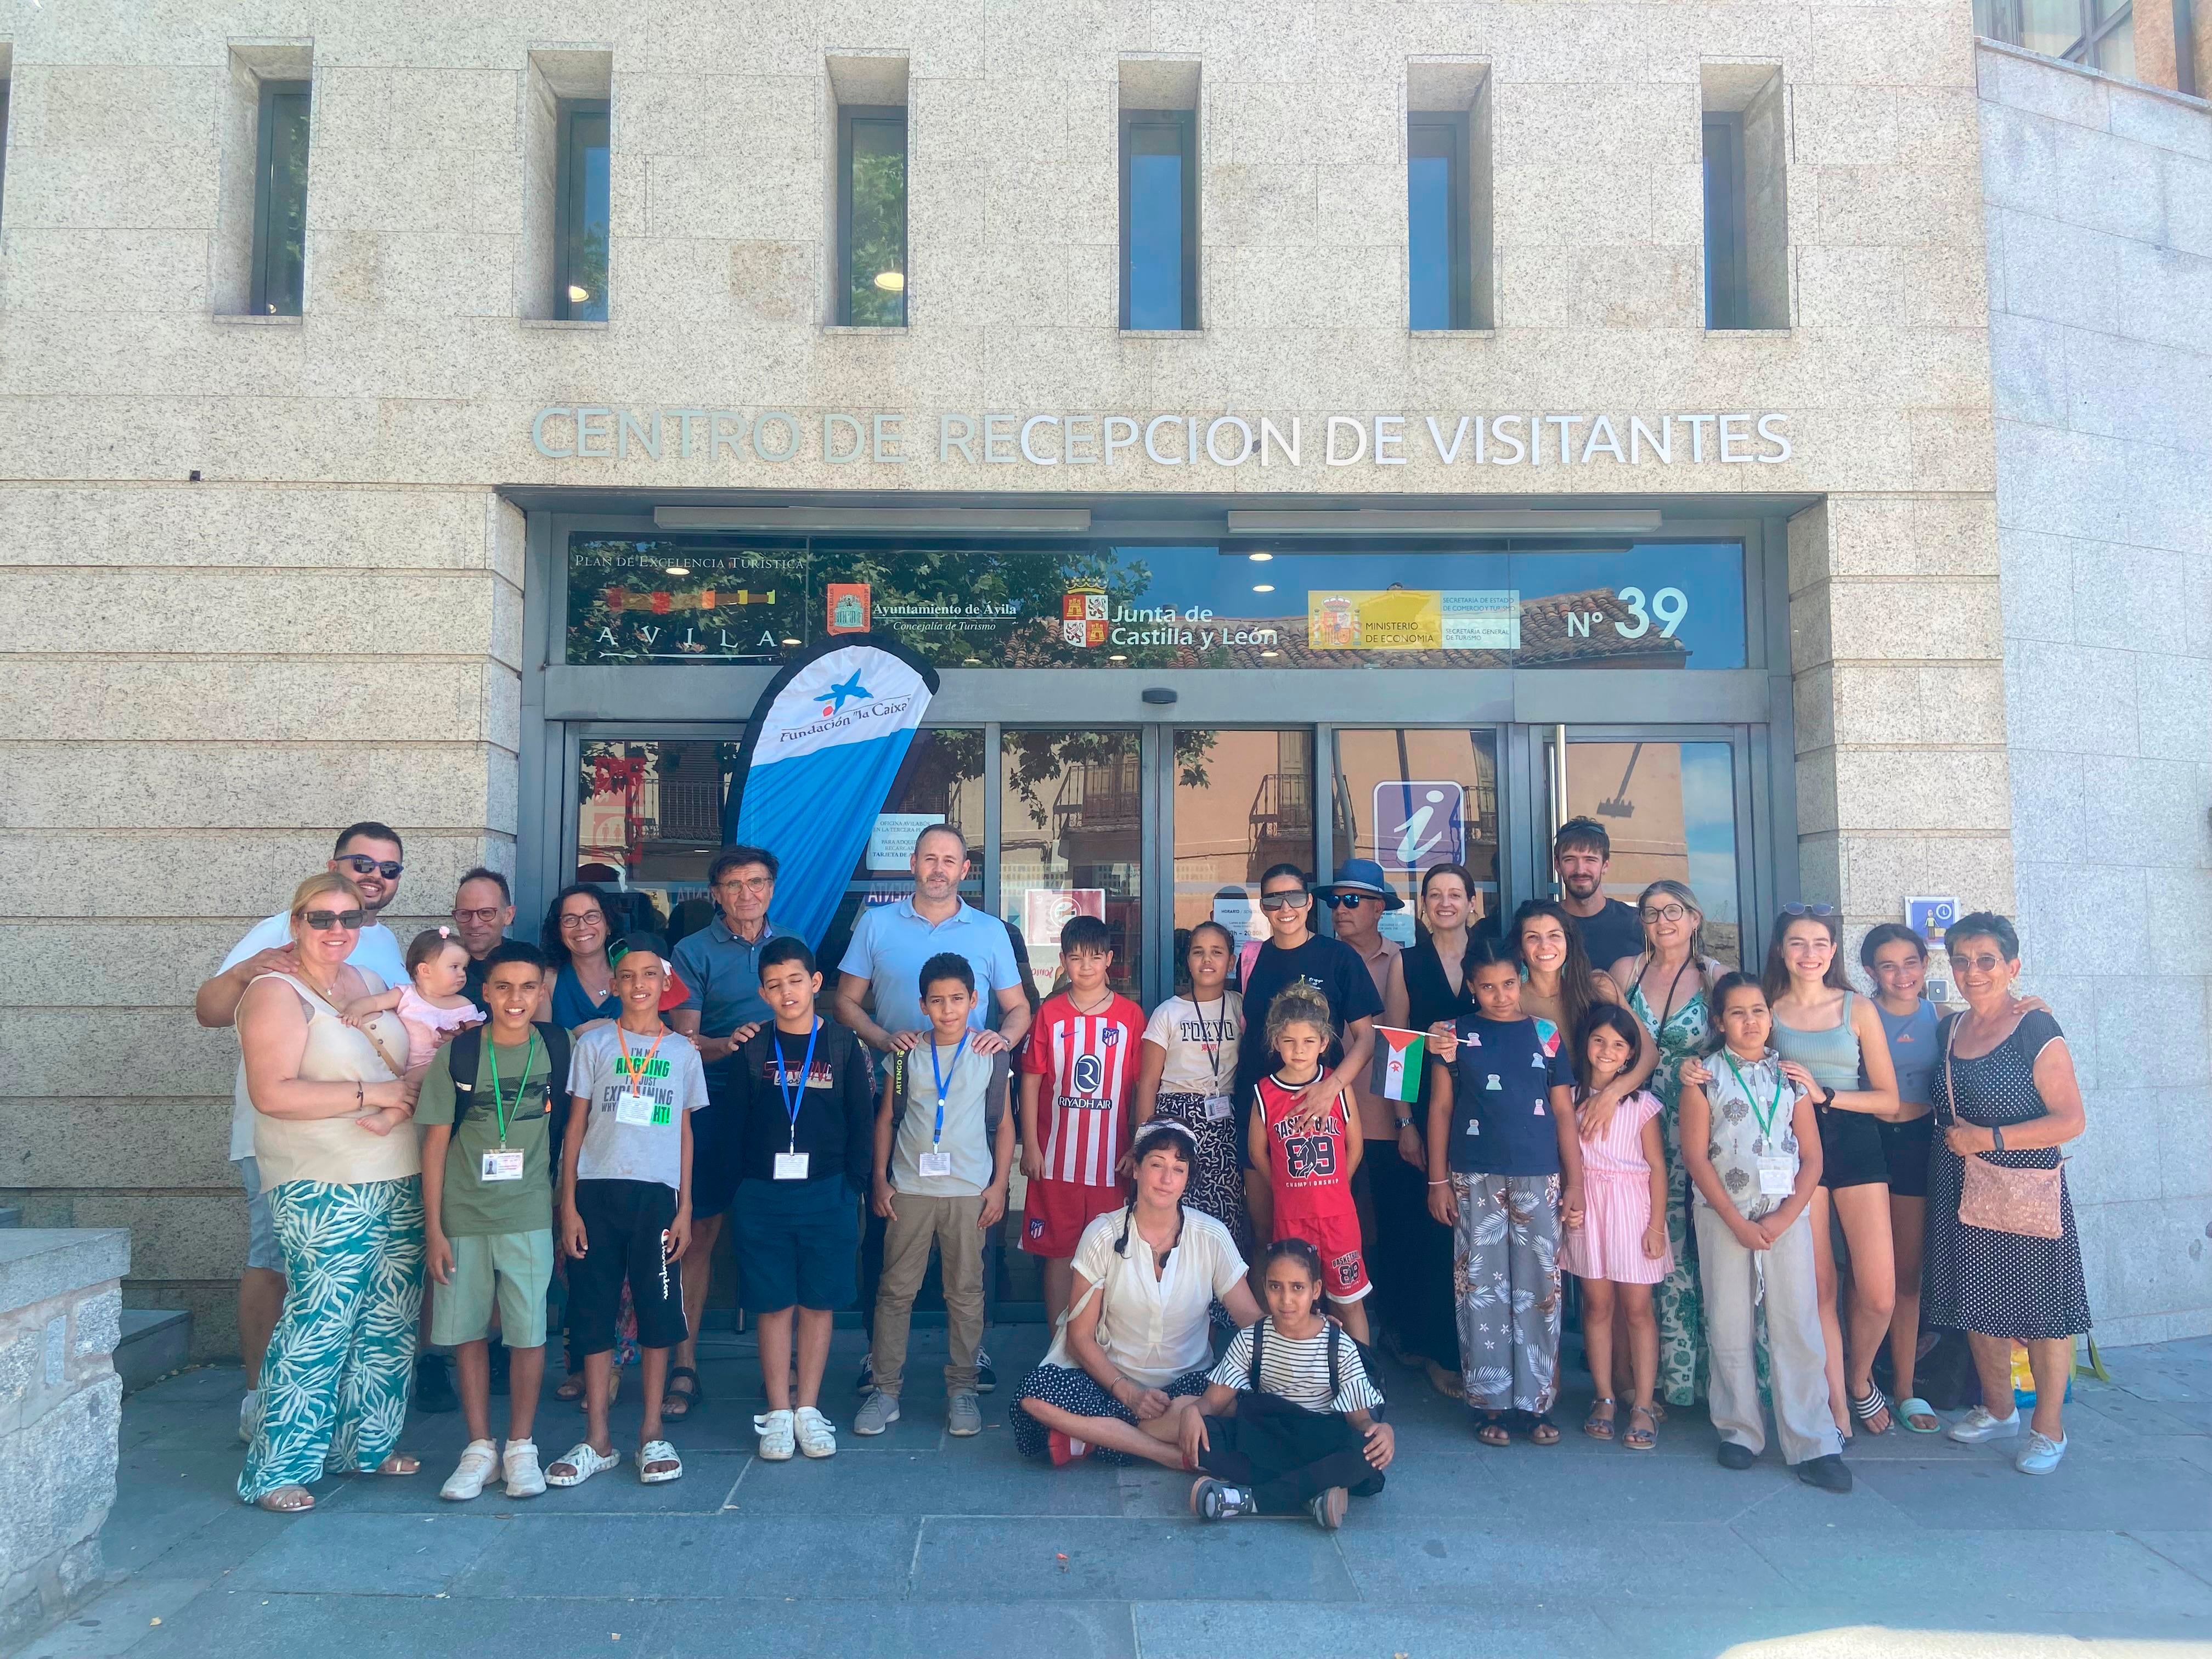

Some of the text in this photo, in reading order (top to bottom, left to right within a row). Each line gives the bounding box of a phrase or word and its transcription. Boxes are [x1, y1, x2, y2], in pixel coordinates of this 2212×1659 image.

[532, 407, 800, 462] CENTRO
[824, 414, 905, 464] DE
[1326, 416, 1407, 466] DE
[1426, 413, 1792, 464] VISITANTES
[873, 601, 1017, 616] Ayuntamiento de Ávila
[1111, 605, 1214, 623] Junta de
[1615, 586, 1689, 639] 39
[893, 621, 996, 632] Concejalía de Turismo
[1365, 622, 1419, 630] MINISTERIO
[1111, 627, 1278, 650] Castilla y León
[780, 716, 851, 742] Fundación
[1180, 1019, 1235, 1042] TOKYO
[639, 1075, 657, 1086] JUST
[601, 1102, 617, 1112] WHY
[1059, 1097, 1111, 1109] RIYADH AIR
[1284, 1134, 1336, 1179] 89
[1285, 1178, 1339, 1187] CHAMPIONSHIP
